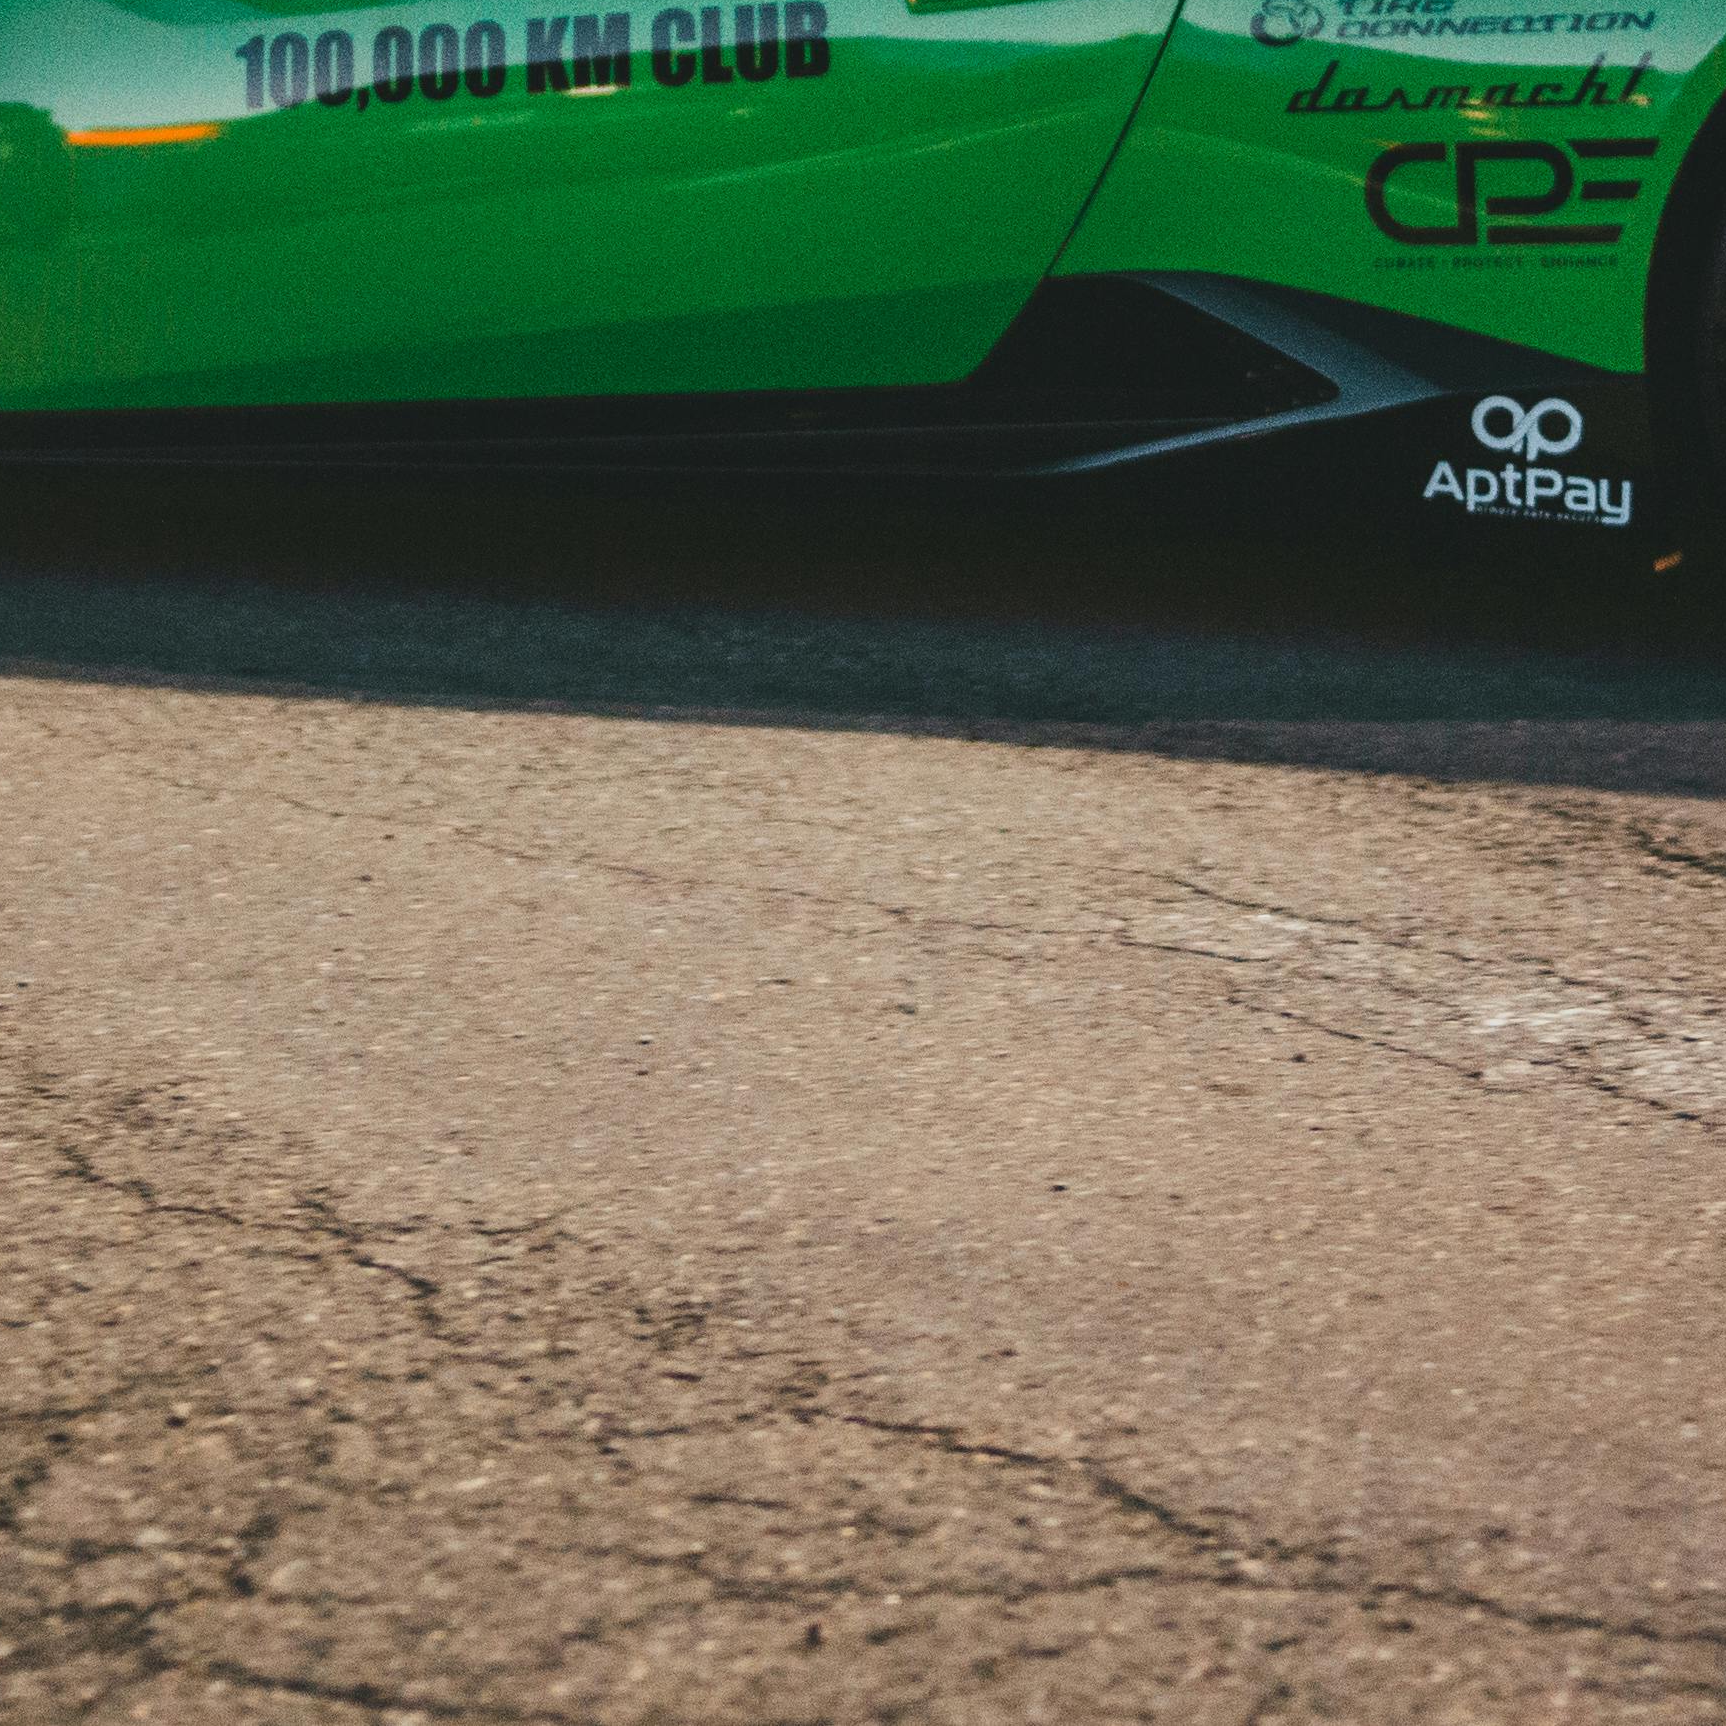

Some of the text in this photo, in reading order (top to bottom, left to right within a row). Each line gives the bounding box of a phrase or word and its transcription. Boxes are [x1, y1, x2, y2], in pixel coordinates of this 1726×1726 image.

[235, 0, 830, 112] 100,000 KM CLUB
[1336, 11, 1656, 39] CONNECTION
[1365, 139, 1659, 244] CPE
[1422, 460, 1633, 526] AptPay
